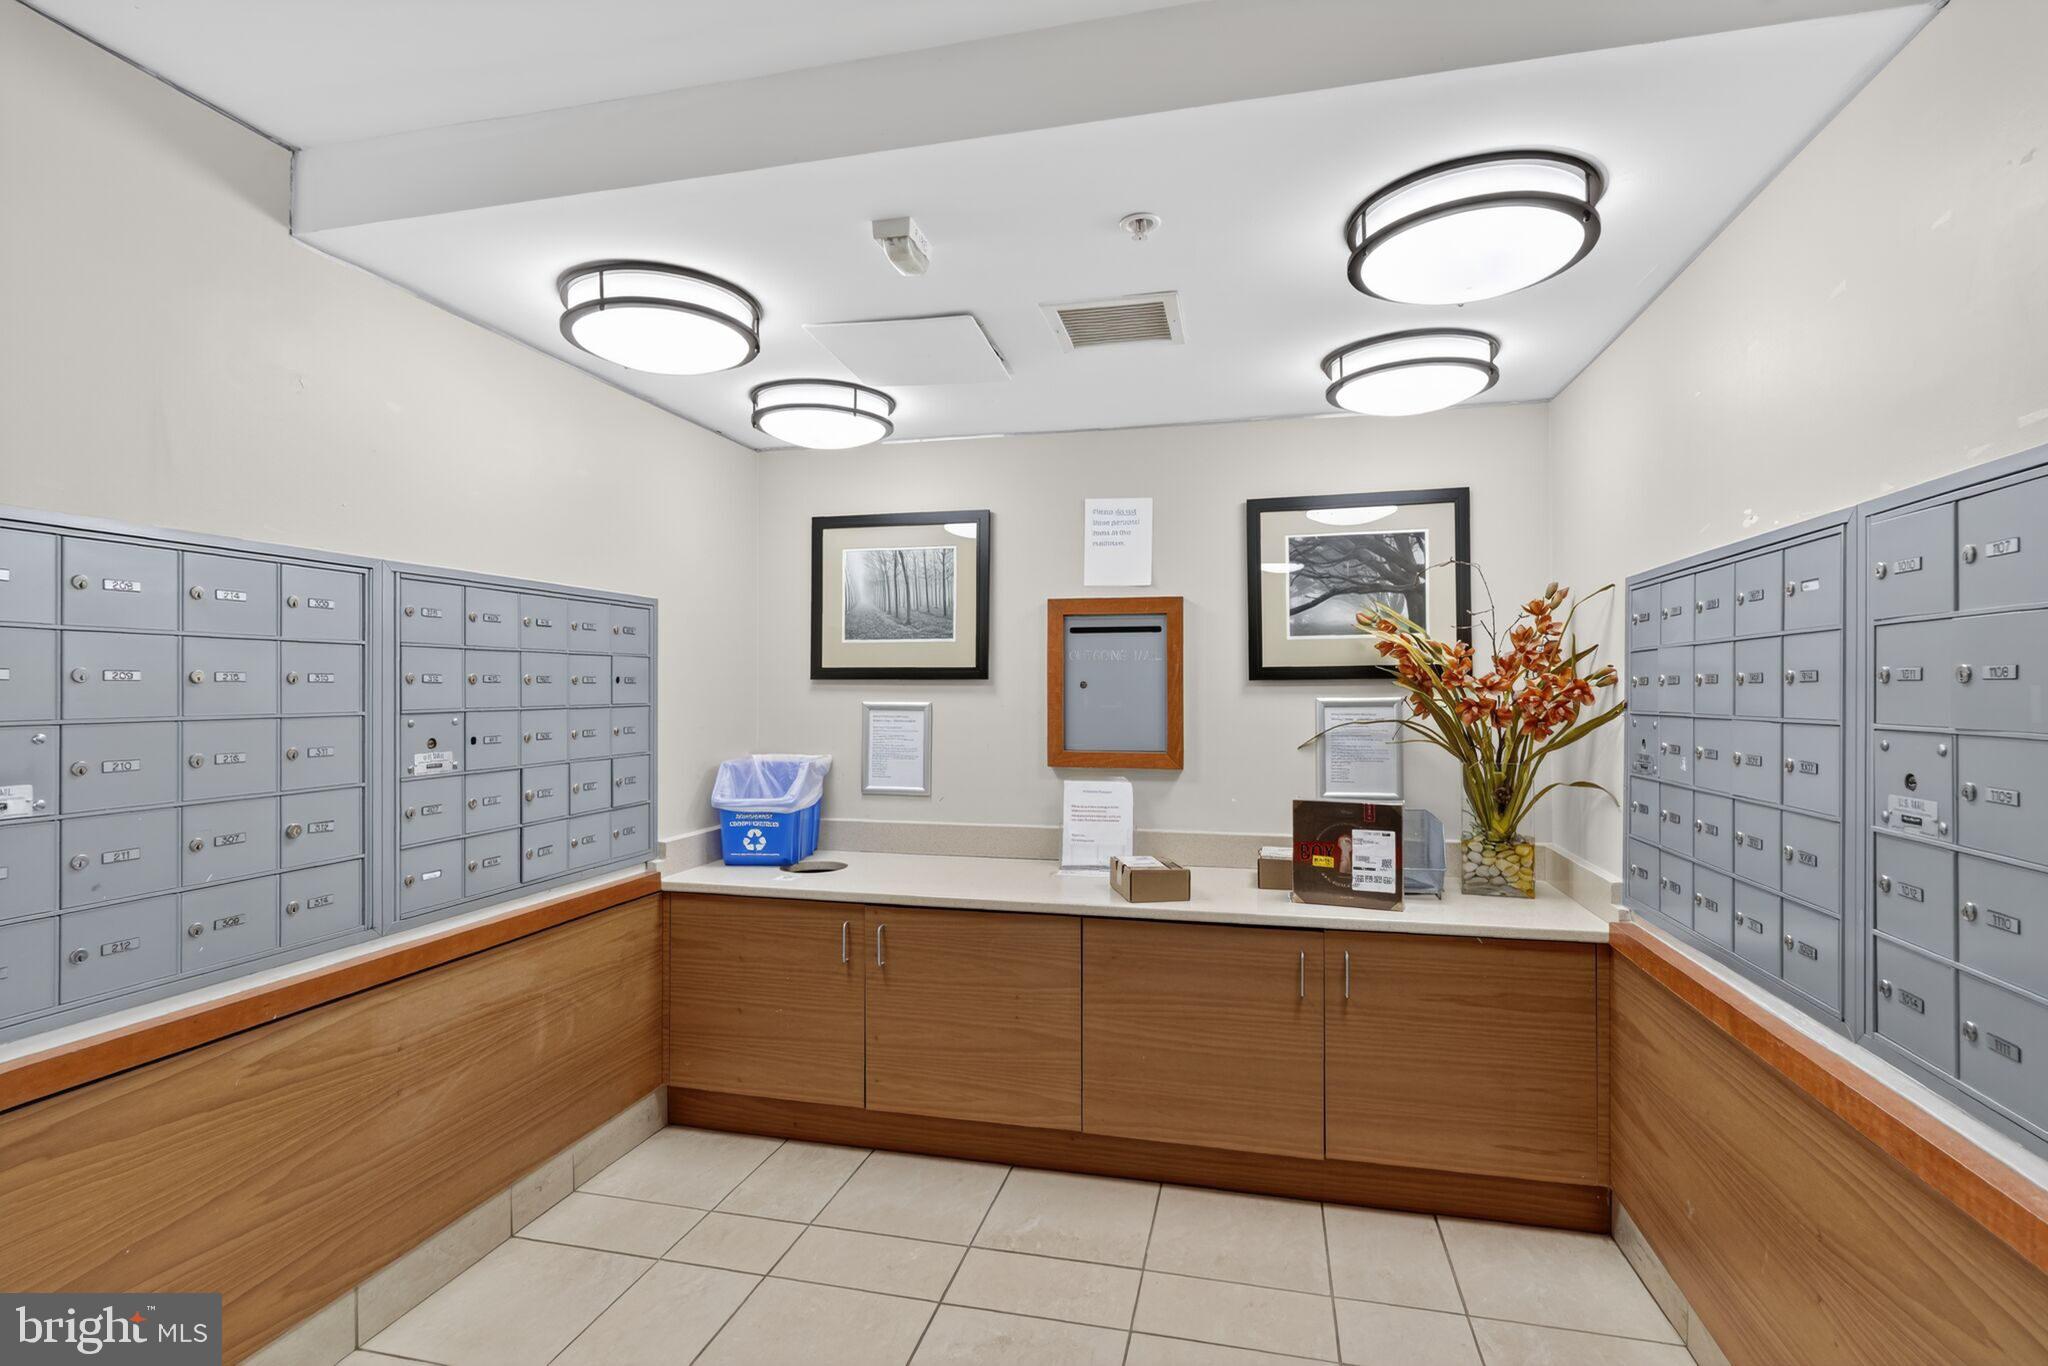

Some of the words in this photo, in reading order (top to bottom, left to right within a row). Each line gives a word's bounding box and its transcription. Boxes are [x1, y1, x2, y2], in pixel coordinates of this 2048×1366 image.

[1993, 541, 2011, 554] 1107
[112, 671, 134, 680] 209
[1989, 666, 2009, 678] 1108
[113, 761, 132, 772] 210
[1991, 790, 2013, 804] 1109
[113, 851, 130, 862] 211
[1901, 885, 1918, 899] 1012
[1992, 914, 2011, 930] 1110
[112, 941, 131, 953] 212
